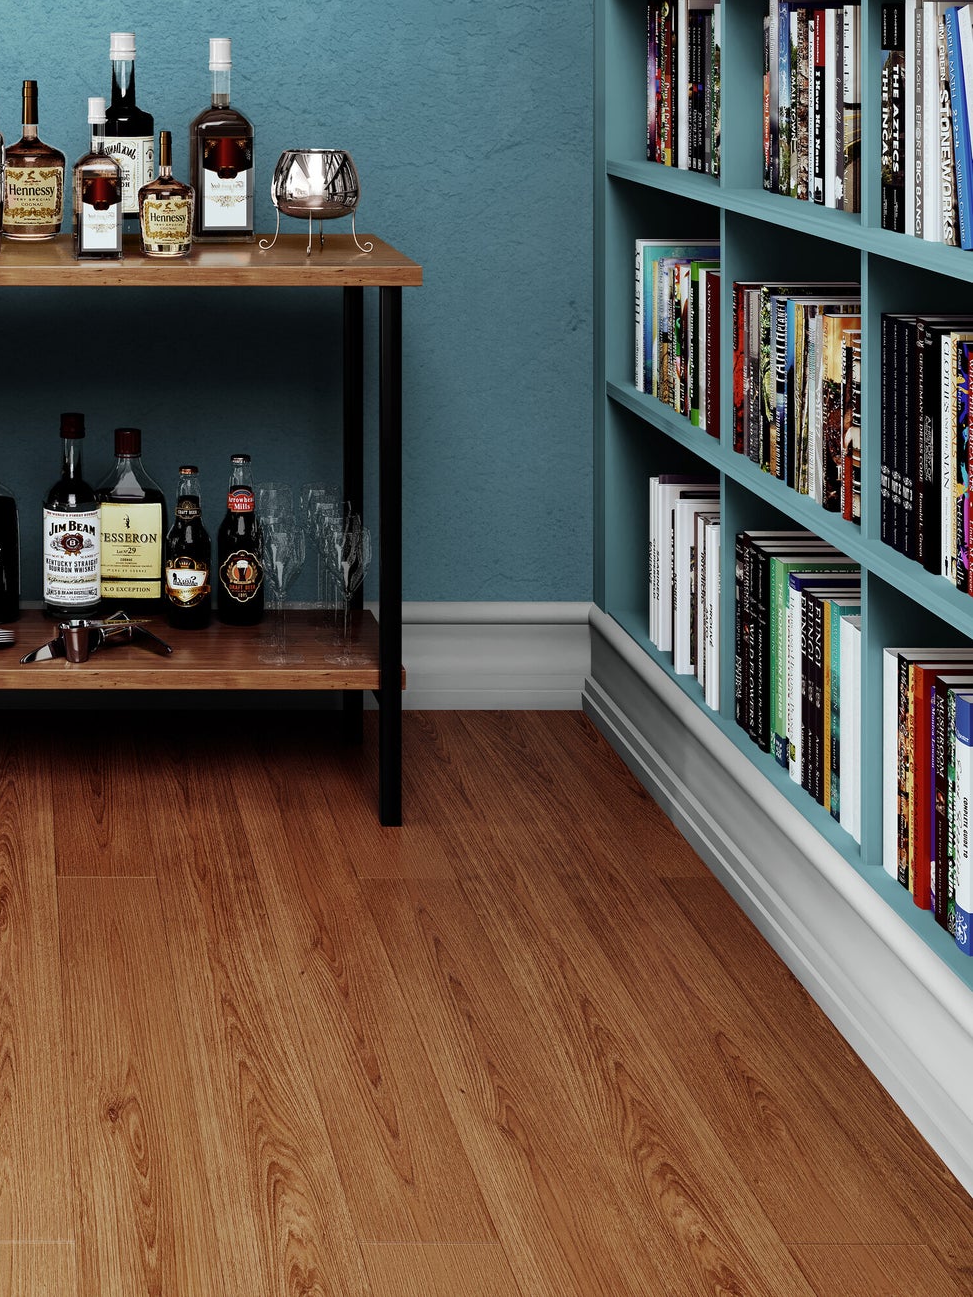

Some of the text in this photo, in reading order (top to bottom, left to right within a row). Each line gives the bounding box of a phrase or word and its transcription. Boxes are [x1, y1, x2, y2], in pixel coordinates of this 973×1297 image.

[940, 90, 953, 240] STONEWORKS
[9, 184, 55, 197] Hennessy
[150, 212, 186, 223] Hennessy
[49, 520, 96, 536] JIM BEAM
[101, 533, 157, 543] ESSERON
[46, 558, 72, 567] KENTUCKY
[74, 558, 98, 568] STRAIGHT
